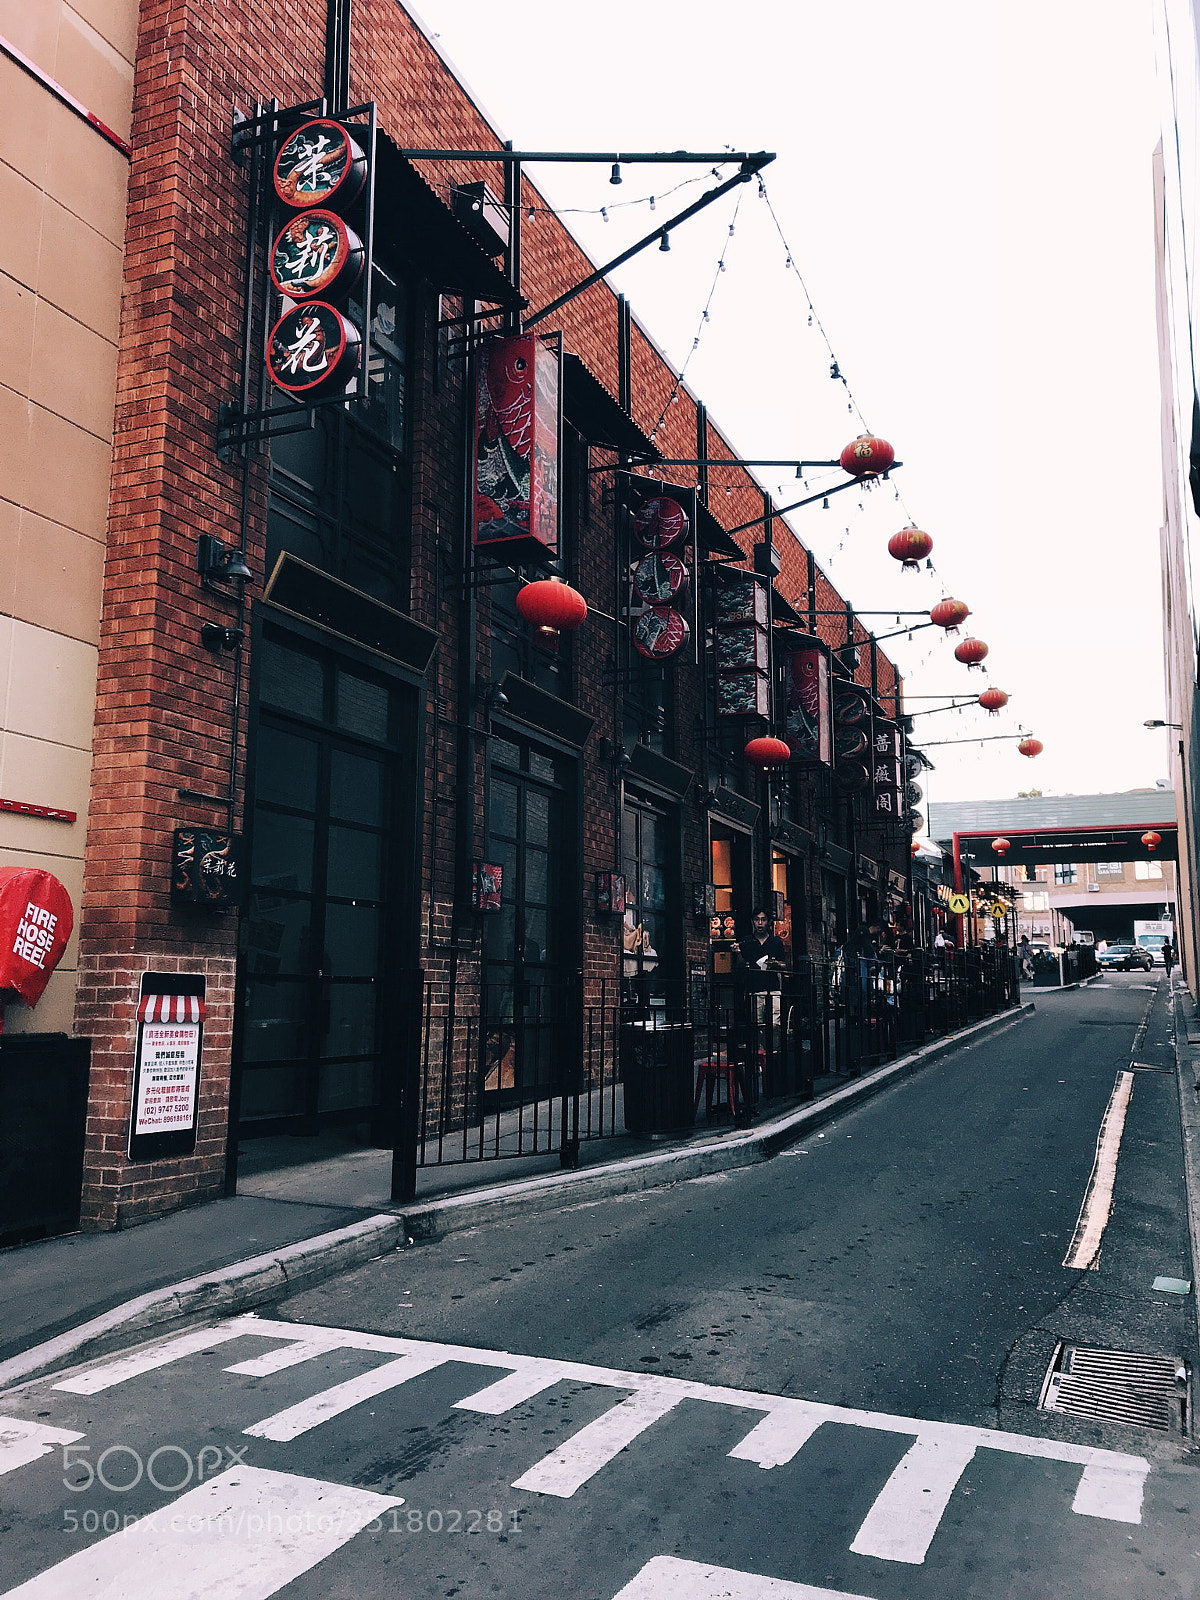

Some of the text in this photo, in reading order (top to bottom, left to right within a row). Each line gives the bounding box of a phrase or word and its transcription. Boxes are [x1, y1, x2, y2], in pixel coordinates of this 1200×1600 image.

[281, 135, 332, 375] 茉莉花
[854, 442, 873, 458] 福
[203, 859, 237, 877] 茉莉花
[25, 902, 58, 933] FIRE
[17, 918, 55, 952] HOSE
[13, 936, 45, 970] REEL
[139, 1117, 162, 1126] WeChat:
[144, 1104, 189, 1116] (02) 9747 5200
